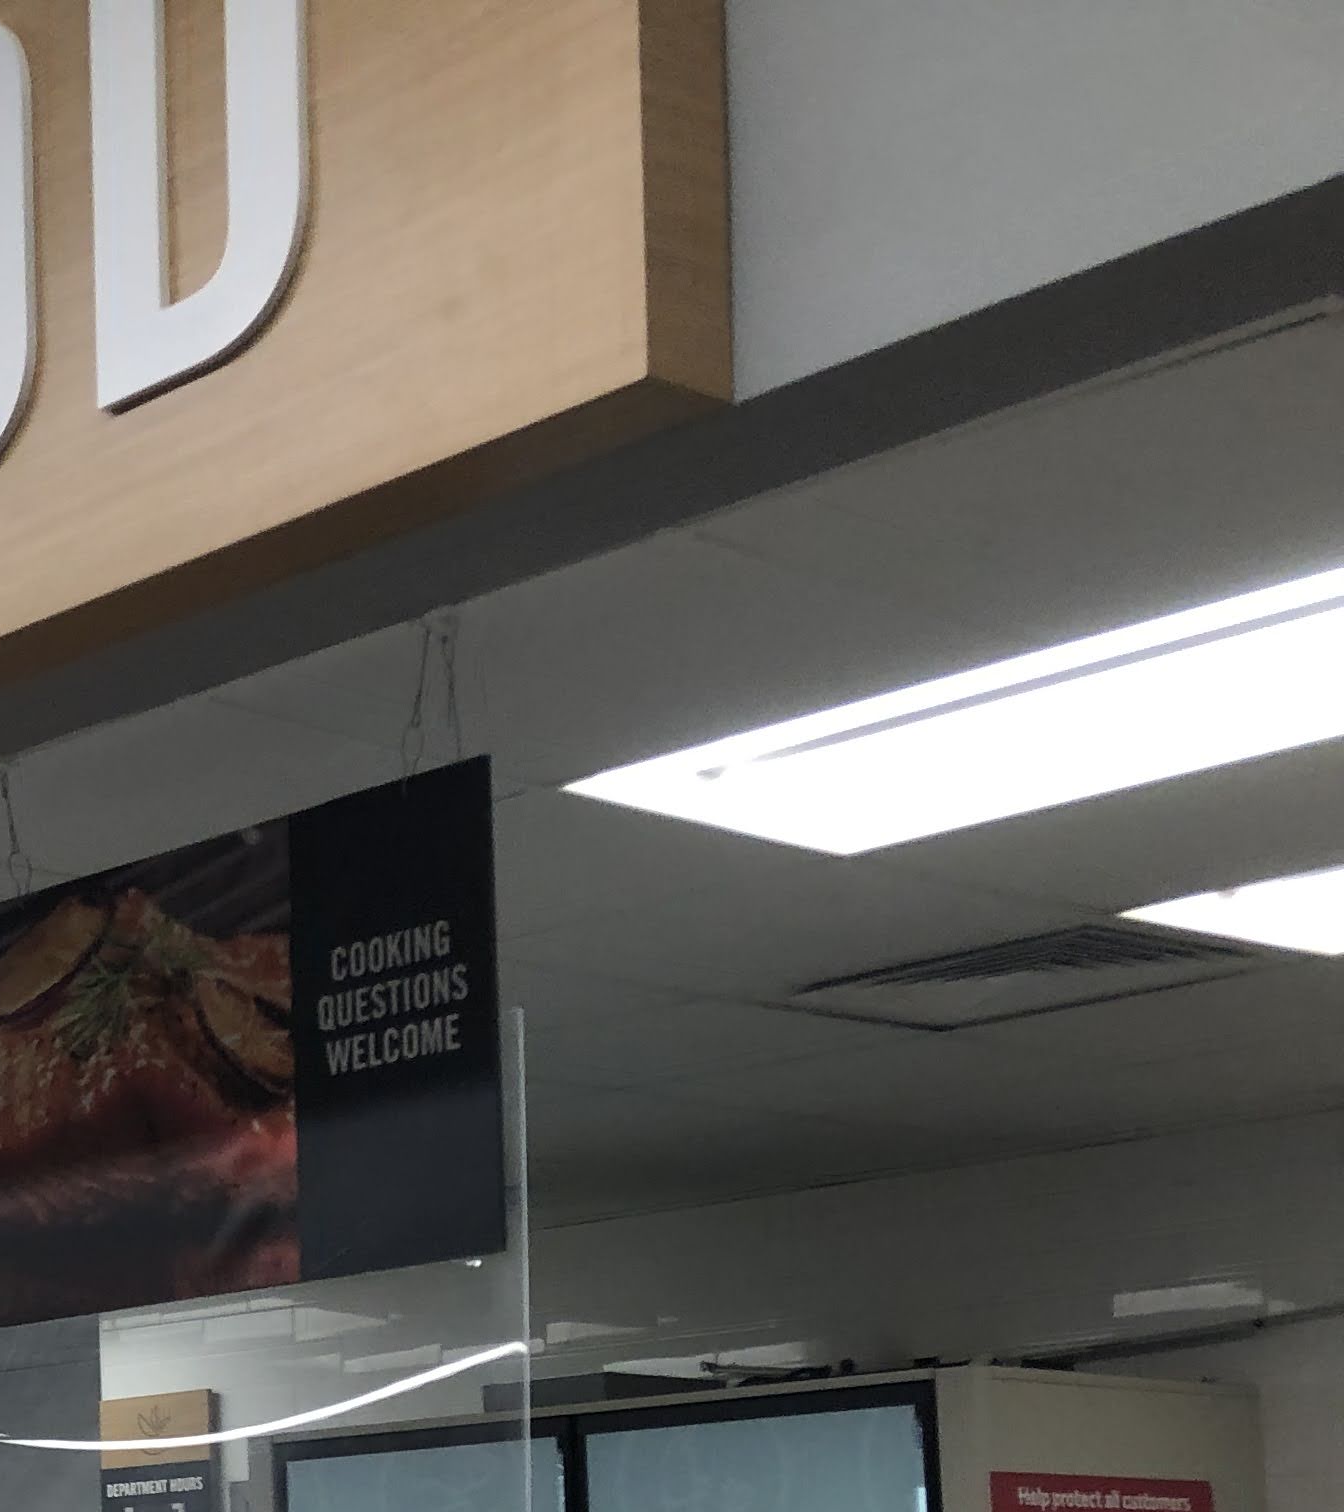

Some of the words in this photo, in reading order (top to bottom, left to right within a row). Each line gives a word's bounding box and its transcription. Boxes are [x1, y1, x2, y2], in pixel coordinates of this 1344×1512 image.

[330, 919, 451, 982] COOKING
[316, 964, 469, 1032] QUESTIONS
[325, 1012, 462, 1077] WELCOME
[106, 1478, 168, 1498] DEPARTMENT
[170, 1476, 204, 1493] HOURS
[1018, 1486, 1050, 1511] Help
[1052, 1489, 1103, 1510] protect
[1105, 1490, 1120, 1509] all
[1122, 1493, 1191, 1512] customers
